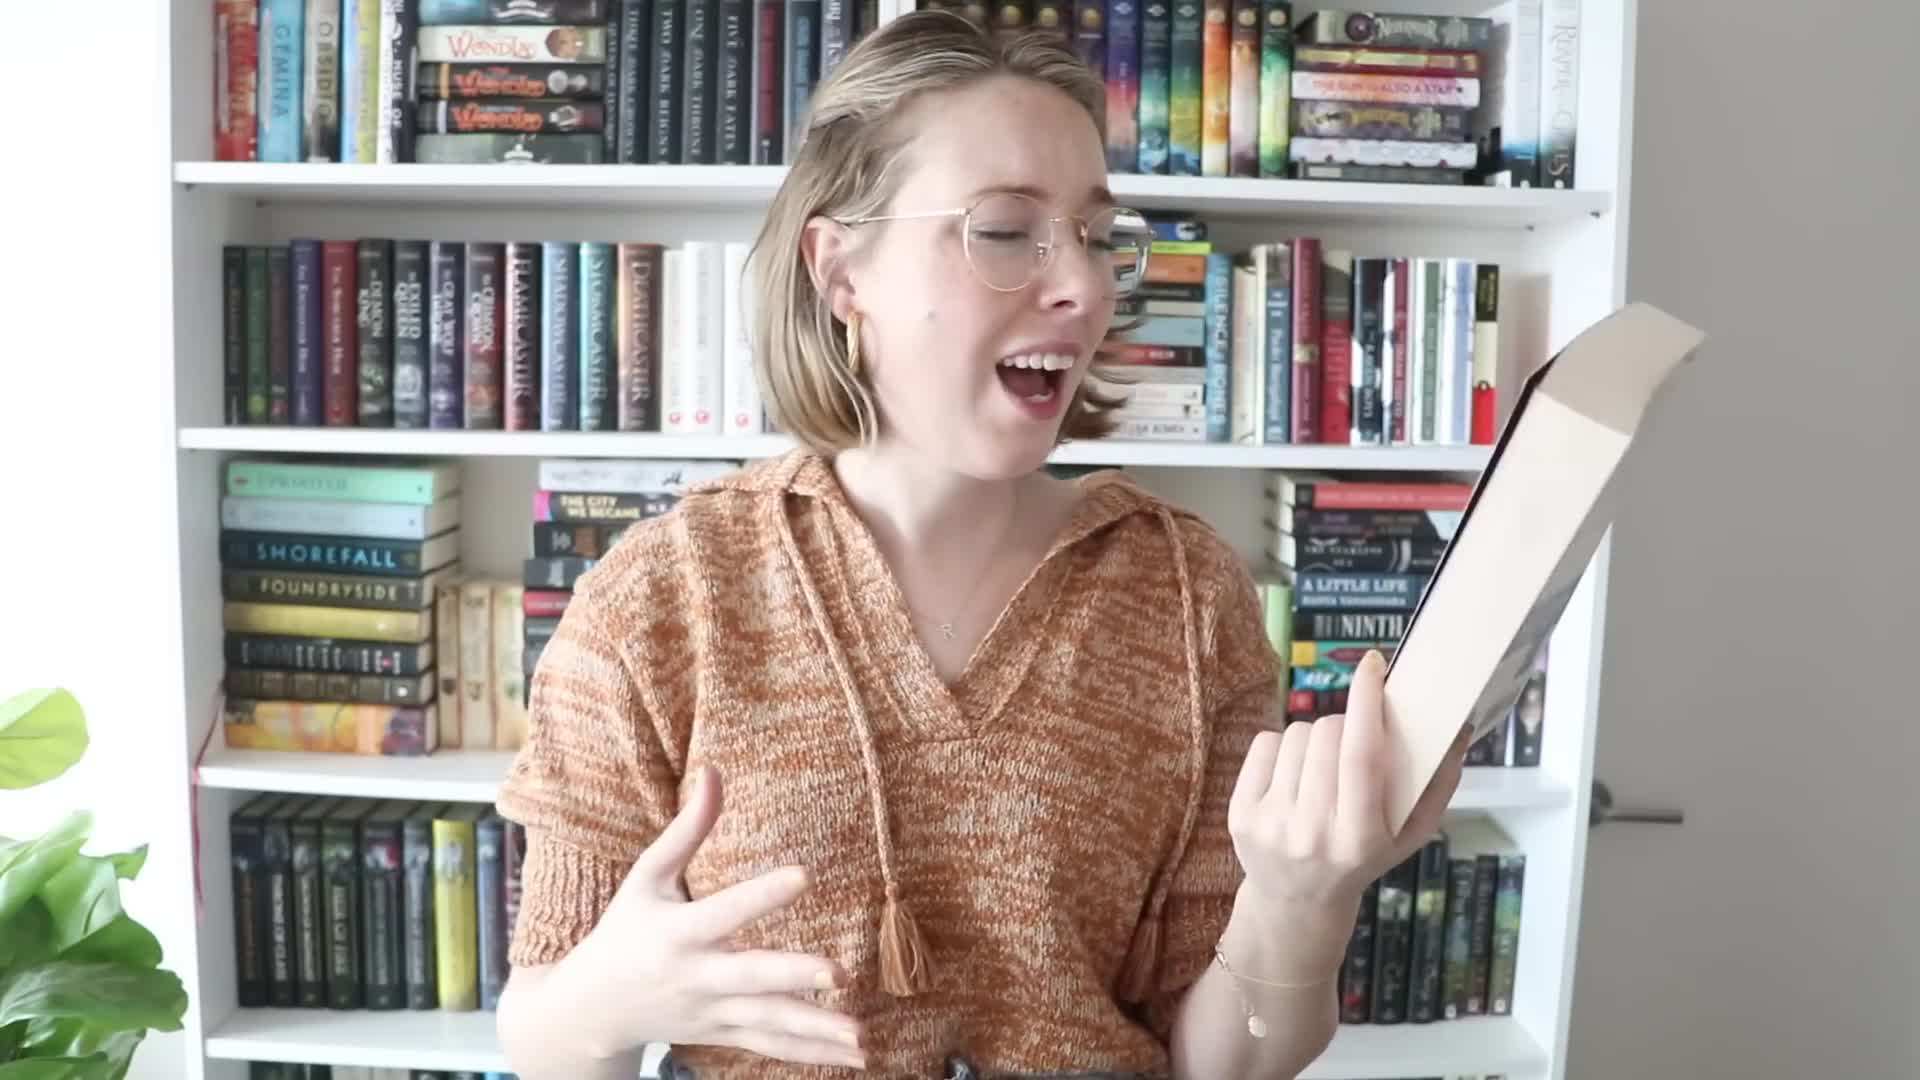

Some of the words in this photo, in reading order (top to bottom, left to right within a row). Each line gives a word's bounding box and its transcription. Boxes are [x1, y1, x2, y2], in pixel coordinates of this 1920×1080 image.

[661, 8, 674, 45] TWO
[689, 8, 705, 41] ONE
[726, 15, 739, 48] FIVE
[660, 49, 672, 93] DARK
[692, 48, 704, 90] DARK
[725, 56, 737, 99] DARK
[690, 96, 703, 156] THRONE
[724, 105, 736, 151] FATES
[357, 288, 370, 329] KING
[370, 280, 383, 338] DEMON
[394, 281, 408, 338] QUEEN
[409, 282, 422, 339] EXILED
[442, 281, 455, 315] GRAY
[481, 286, 496, 352] CRIMSON
[442, 319, 455, 355] WOLF
[513, 258, 532, 401] FLAMECASTER
[551, 255, 568, 406] SHADOWCASTER
[590, 259, 607, 401] STORMCASTER
[631, 261, 650, 401] DEATHCASTER
[560, 494, 585, 506] THE
[587, 495, 618, 507] CITY
[568, 507, 587, 518] WE
[589, 507, 641, 519] BECAME
[257, 543, 397, 568] SHOREFALL
[260, 578, 398, 601] FOUNDRYSIDE
[1303, 580, 1314, 592] A
[1316, 579, 1369, 592] LITTLE
[1374, 579, 1408, 592] LIFE
[1342, 614, 1403, 639] NINTH
